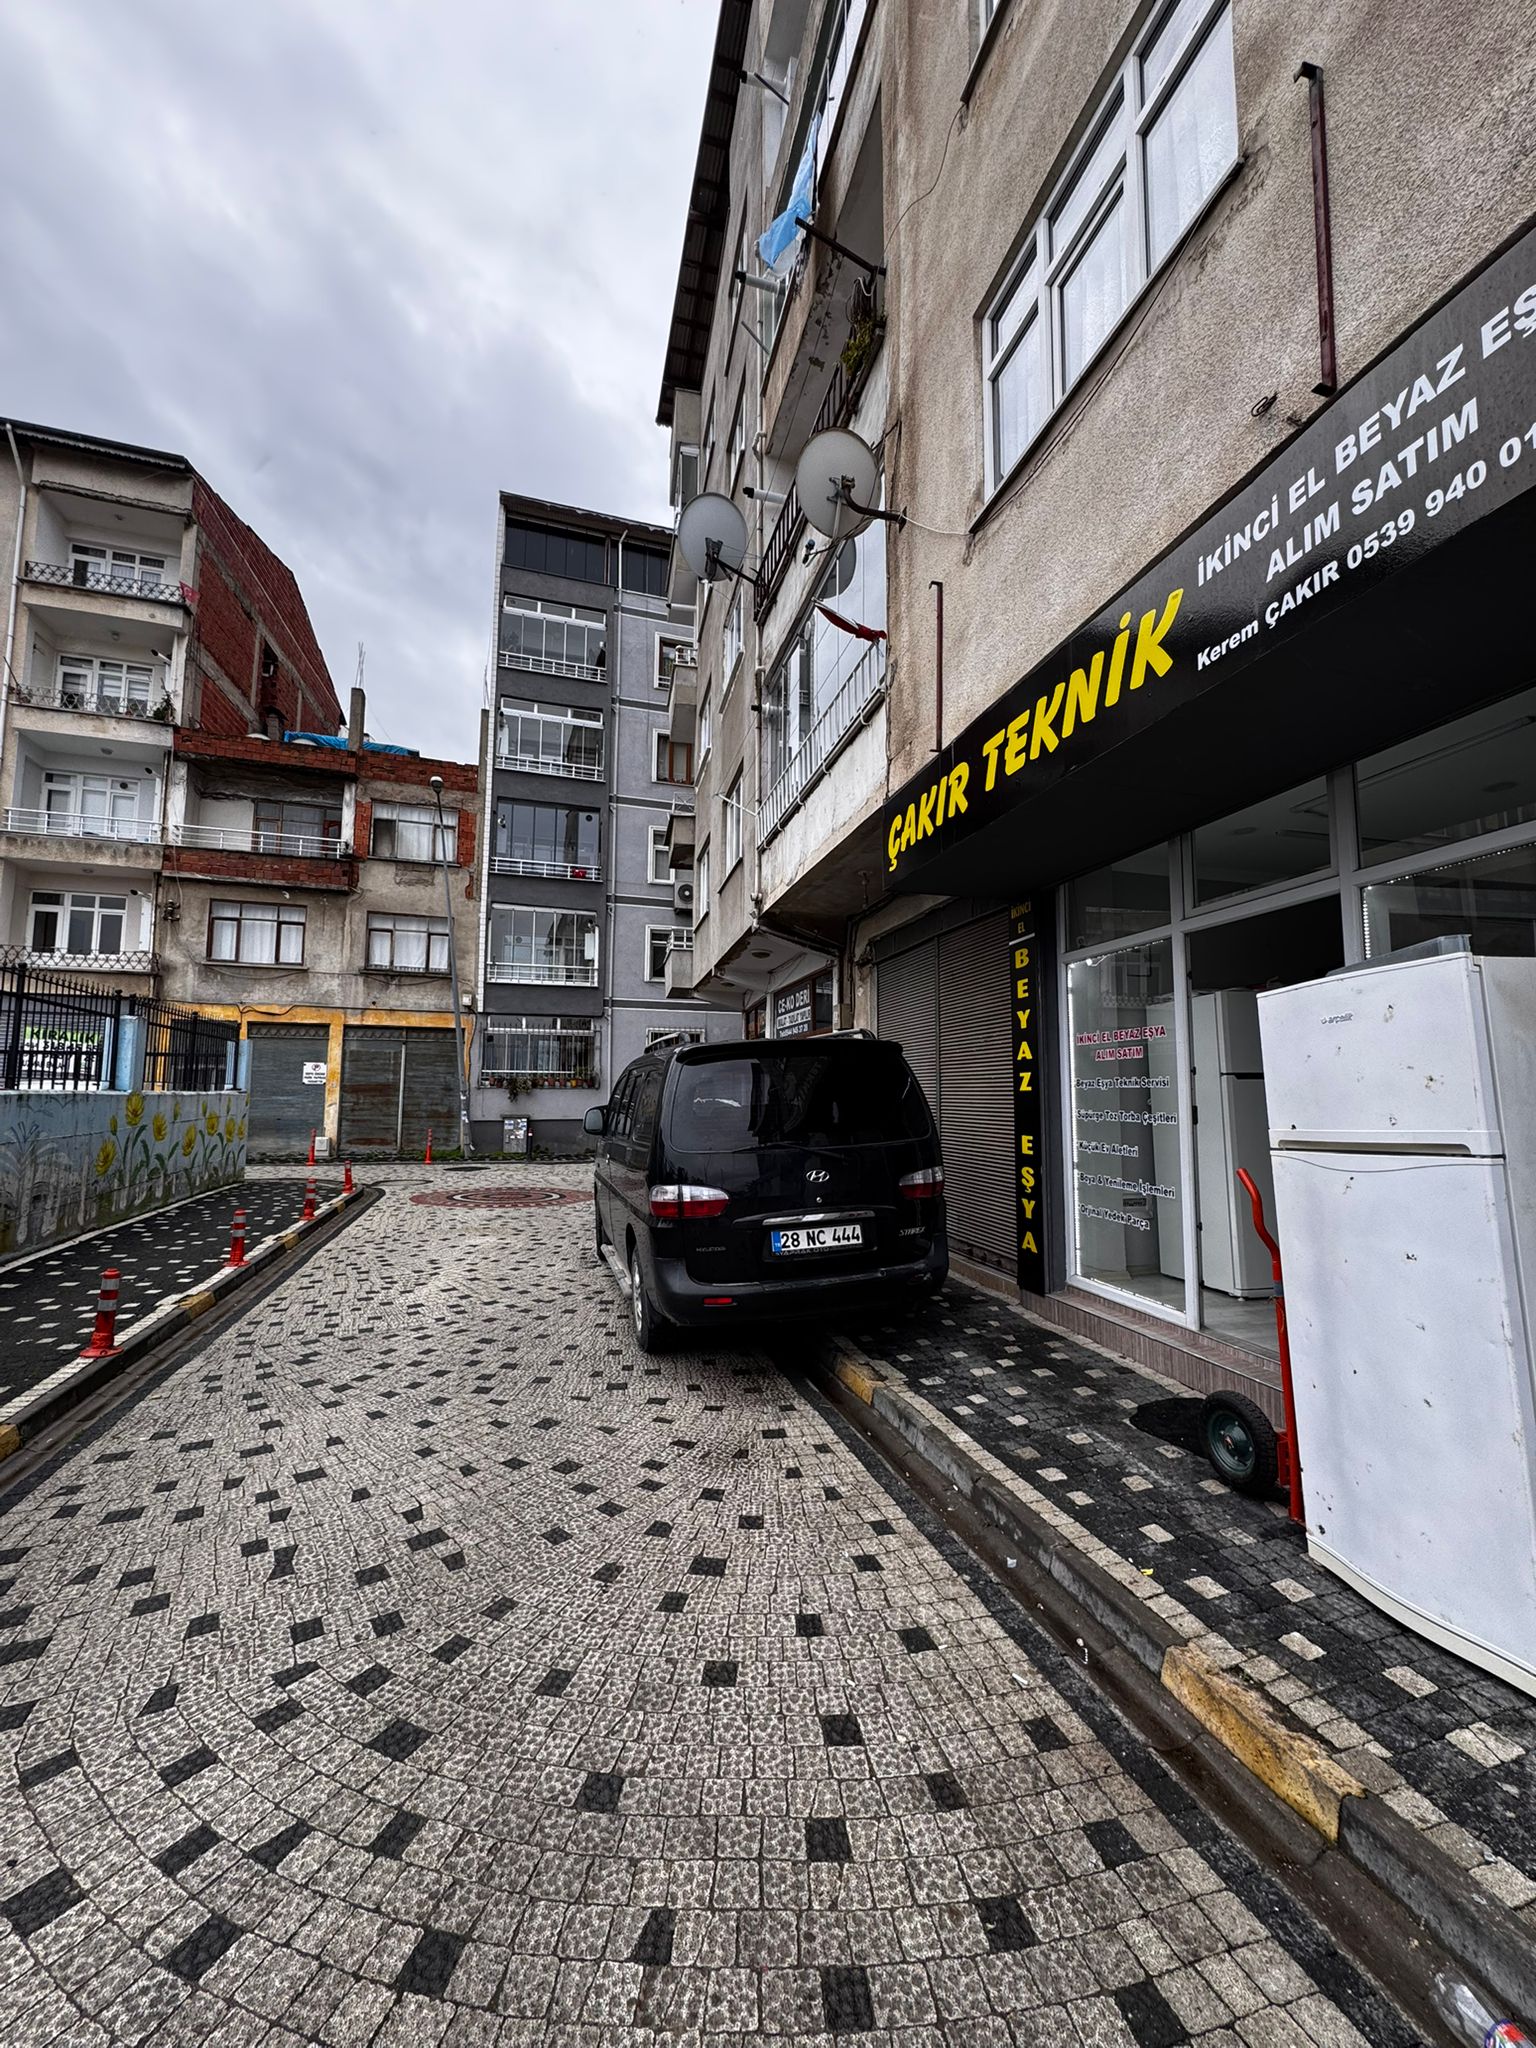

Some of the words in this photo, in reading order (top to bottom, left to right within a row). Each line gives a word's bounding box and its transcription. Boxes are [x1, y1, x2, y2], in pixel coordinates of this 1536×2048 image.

[1198, 494, 1279, 587] İKİNCİ
[1289, 466, 1326, 515] EL
[1335, 343, 1467, 475] BEYAZ
[1266, 501, 1341, 583] ALIM
[1352, 397, 1479, 516] SATIM
[1197, 620, 1259, 671] Kerem
[1265, 560, 1341, 630] ÇAKIR
[1347, 509, 1415, 570] 0539
[1425, 460, 1487, 517] 940
[888, 761, 970, 872] ÇAKIR
[982, 588, 1184, 792] TEKNİK
[1017, 921, 1026, 934] EL
[1015, 948, 1034, 1091] BEYAZ
[1101, 1032, 1112, 1043] EL
[1113, 1028, 1141, 1041] BEYAZ
[1142, 1025, 1167, 1041] EŞYA
[1096, 1048, 1115, 1061] ALIM
[1116, 1046, 1144, 1059] SATIM
[1076, 1078, 1095, 1090] Beyaz
[1114, 1076, 1140, 1088] Teknik
[1141, 1076, 1170, 1089] Servisi
[1104, 1110, 1118, 1121] Toz
[1119, 1110, 1141, 1122] Torba
[1142, 1111, 1178, 1126] Çeşitleri
[1101, 1142, 1110, 1153] Ev
[1111, 1143, 1139, 1157] Aletleri
[1021, 1134, 1038, 1253] EŞYA
[1080, 1172, 1096, 1185] Boya
[1097, 1175, 1104, 1185] &
[1104, 1175, 1138, 1191] Yenileme
[1139, 1178, 1175, 1199] İşlemleri
[1103, 1207, 1127, 1224] Yedek
[1127, 1213, 1150, 1231] Parça
[781, 1232, 801, 1249] 28
[806, 1230, 826, 1247] NC
[832, 1226, 861, 1244] 444
